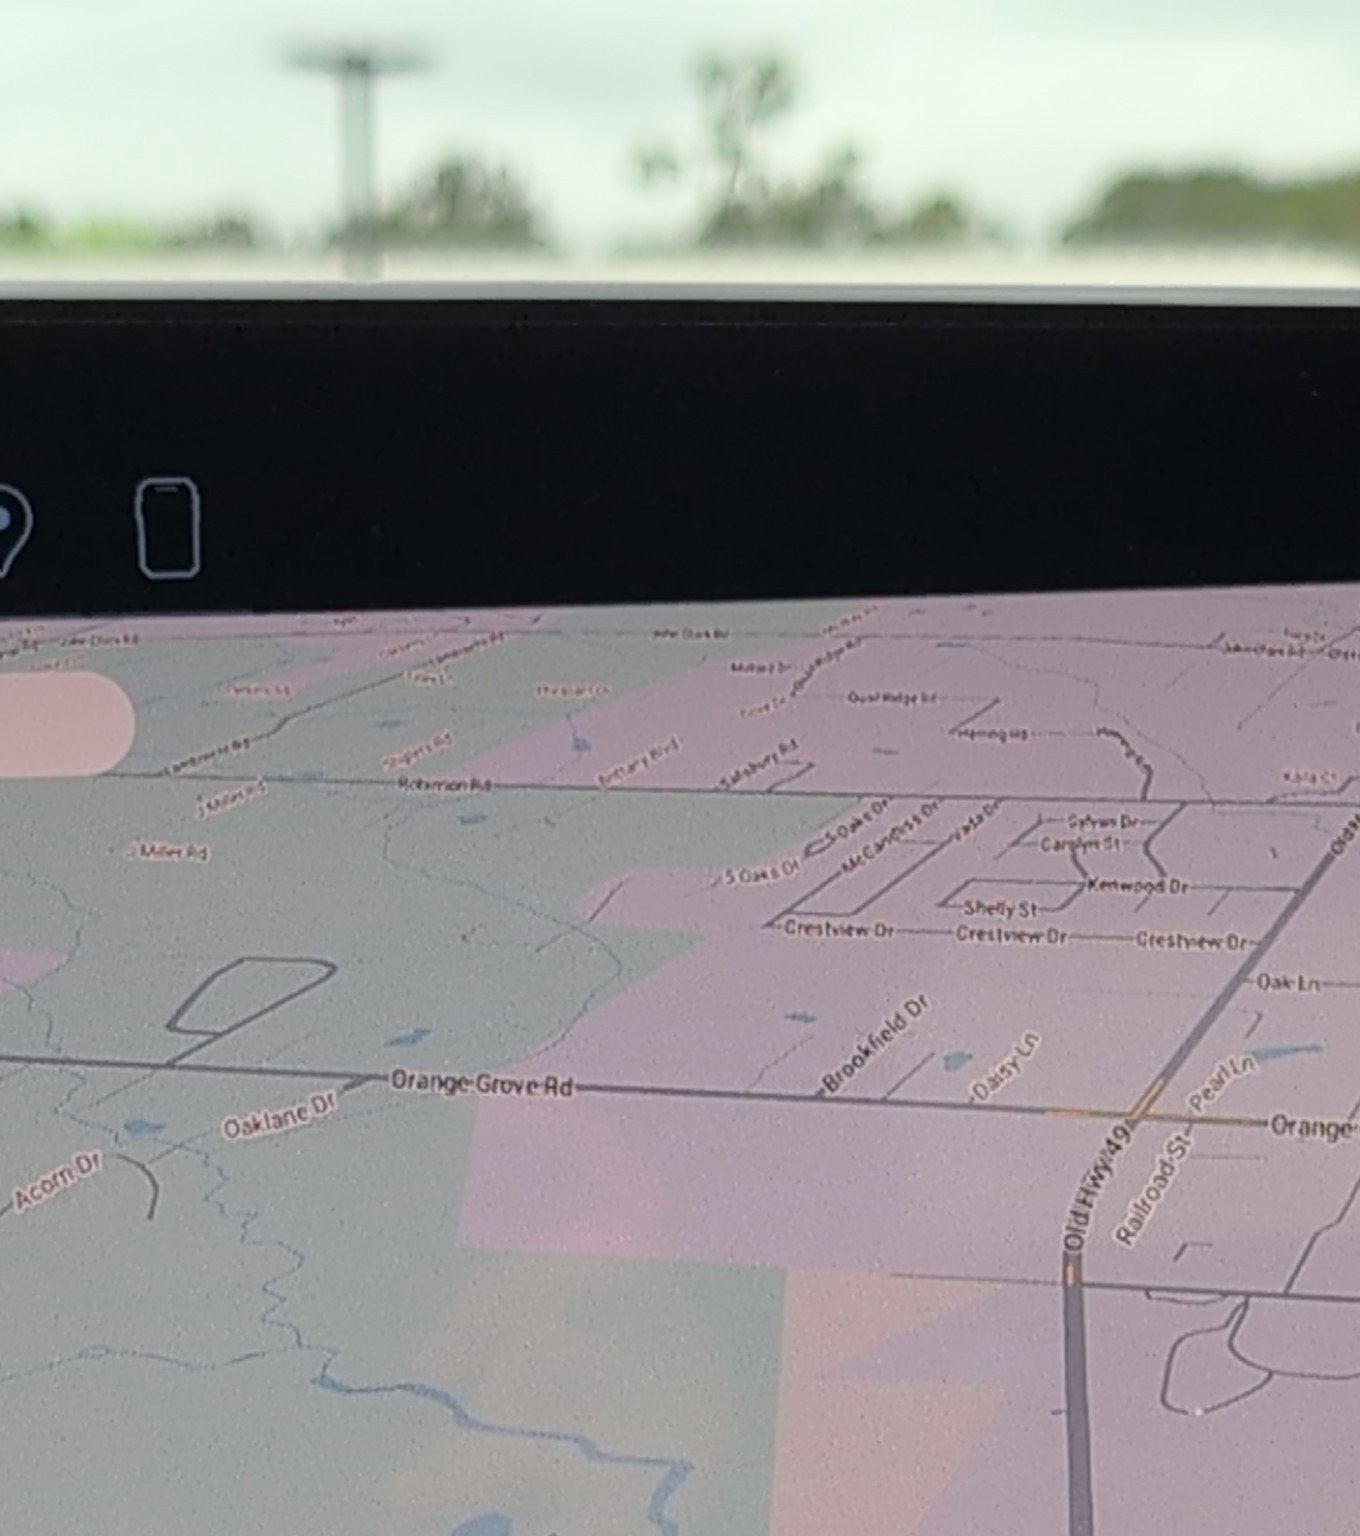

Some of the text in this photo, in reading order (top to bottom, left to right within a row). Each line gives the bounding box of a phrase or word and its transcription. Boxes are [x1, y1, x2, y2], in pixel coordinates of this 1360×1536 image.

[1088, 878, 1189, 896] Kenwood Dr
[963, 899, 1038, 919] Shelly St
[784, 919, 895, 938] Crestview Dr
[956, 925, 1068, 945] Crestview Dr
[1136, 930, 1249, 951] Crestview Dr
[1256, 972, 1321, 993] Oak Ln
[822, 994, 930, 1094] Brookfield Dr
[971, 1032, 1040, 1102] Daisy Ln
[392, 1068, 574, 1098] Orange Grove Rd
[1190, 1055, 1256, 1111] Pearl Ln
[223, 1091, 338, 1139] Oaklane Dr
[1271, 1114, 1353, 1143] Orange
[13, 1150, 104, 1209] Acorn Dr
[1063, 1122, 1133, 1251] Old Hwy 49
[1115, 1131, 1192, 1246] Railroad St
